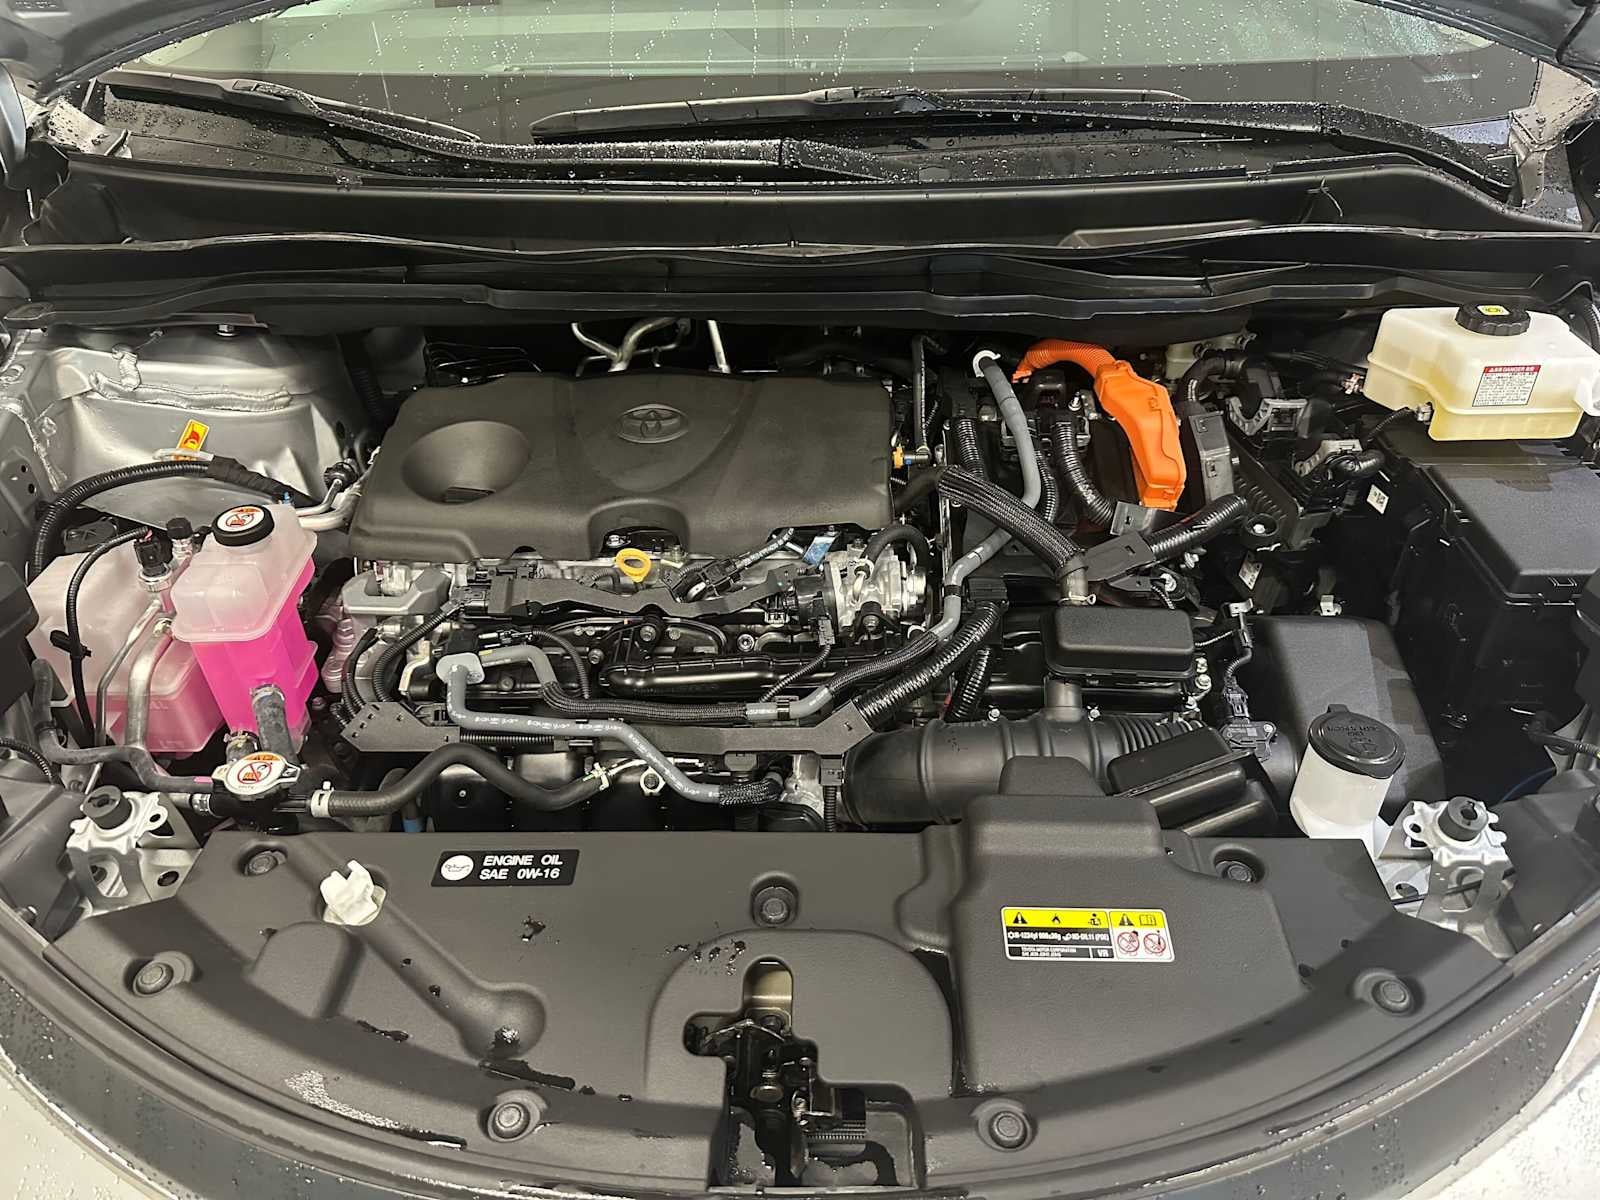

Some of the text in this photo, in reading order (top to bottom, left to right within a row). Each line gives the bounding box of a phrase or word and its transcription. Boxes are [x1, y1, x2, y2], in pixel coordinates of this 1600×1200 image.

[483, 855, 563, 866] ENGINE OIL
[480, 868, 560, 880] SAE 0W-16
